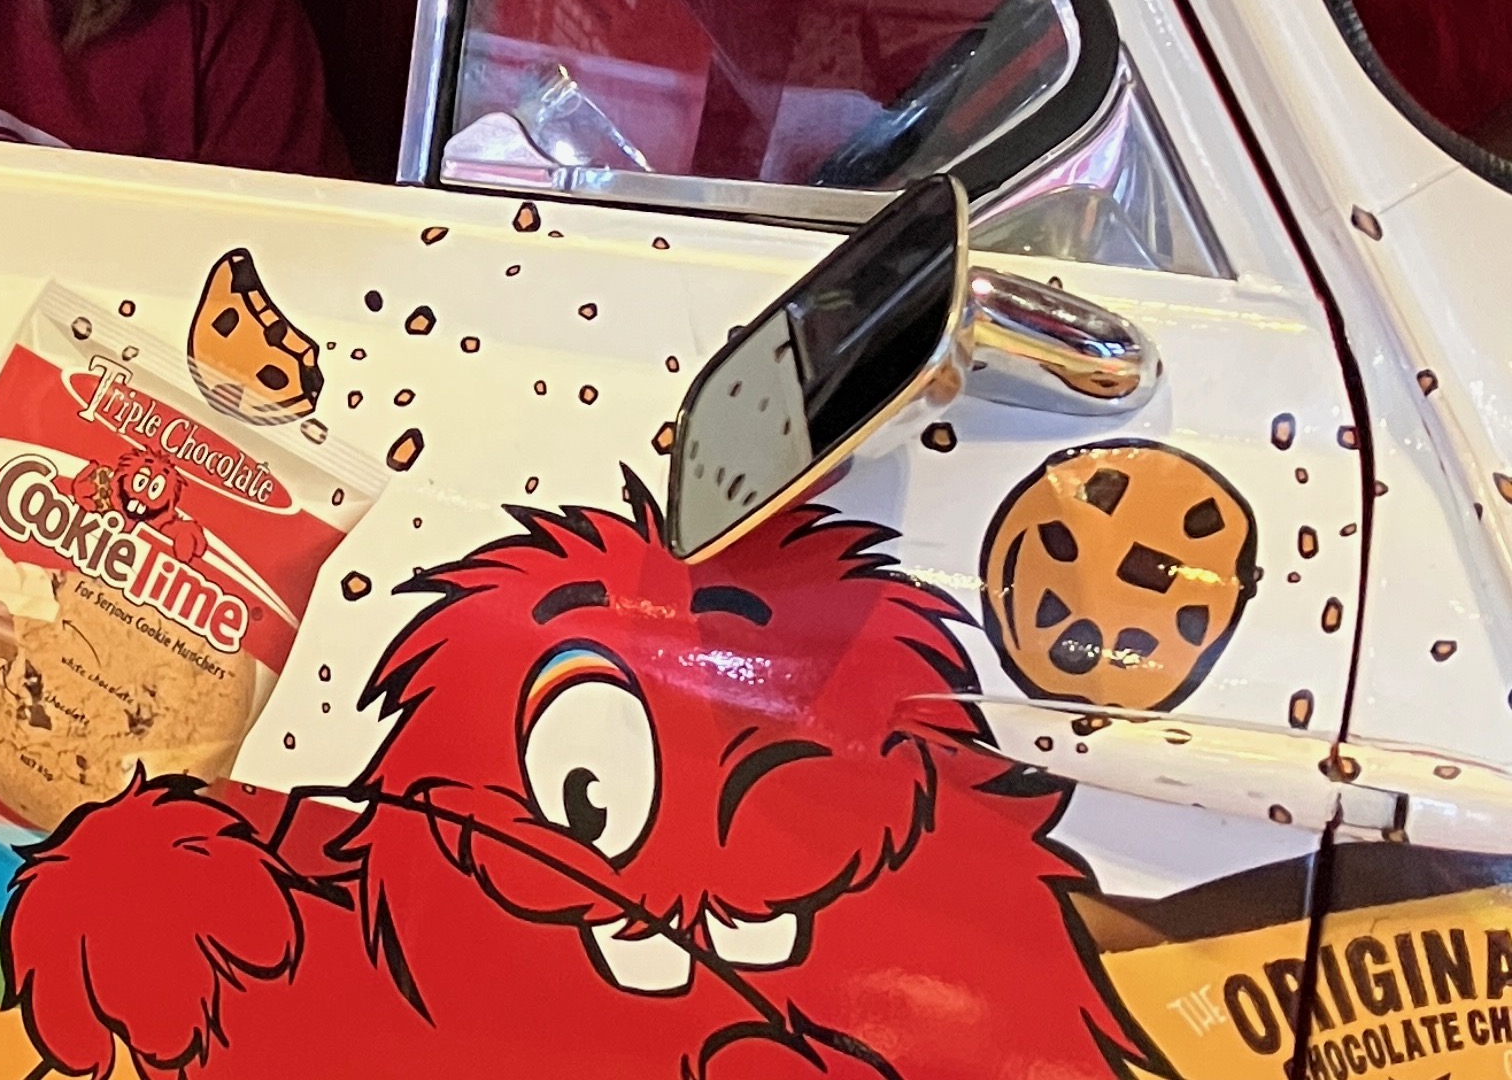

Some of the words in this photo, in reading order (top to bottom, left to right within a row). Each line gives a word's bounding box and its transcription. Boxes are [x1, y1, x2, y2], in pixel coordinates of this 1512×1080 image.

[78, 355, 162, 439] Triple
[159, 417, 275, 504] Chocolate
[74, 580, 95, 601] For
[93, 592, 134, 626] Serious
[135, 617, 173, 648] Cookie
[171, 637, 227, 681] Munchers
[88, 673, 134, 705] chocolate
[1165, 983, 1226, 1037] THE
[1223, 926, 1512, 1055] ORIGINA
